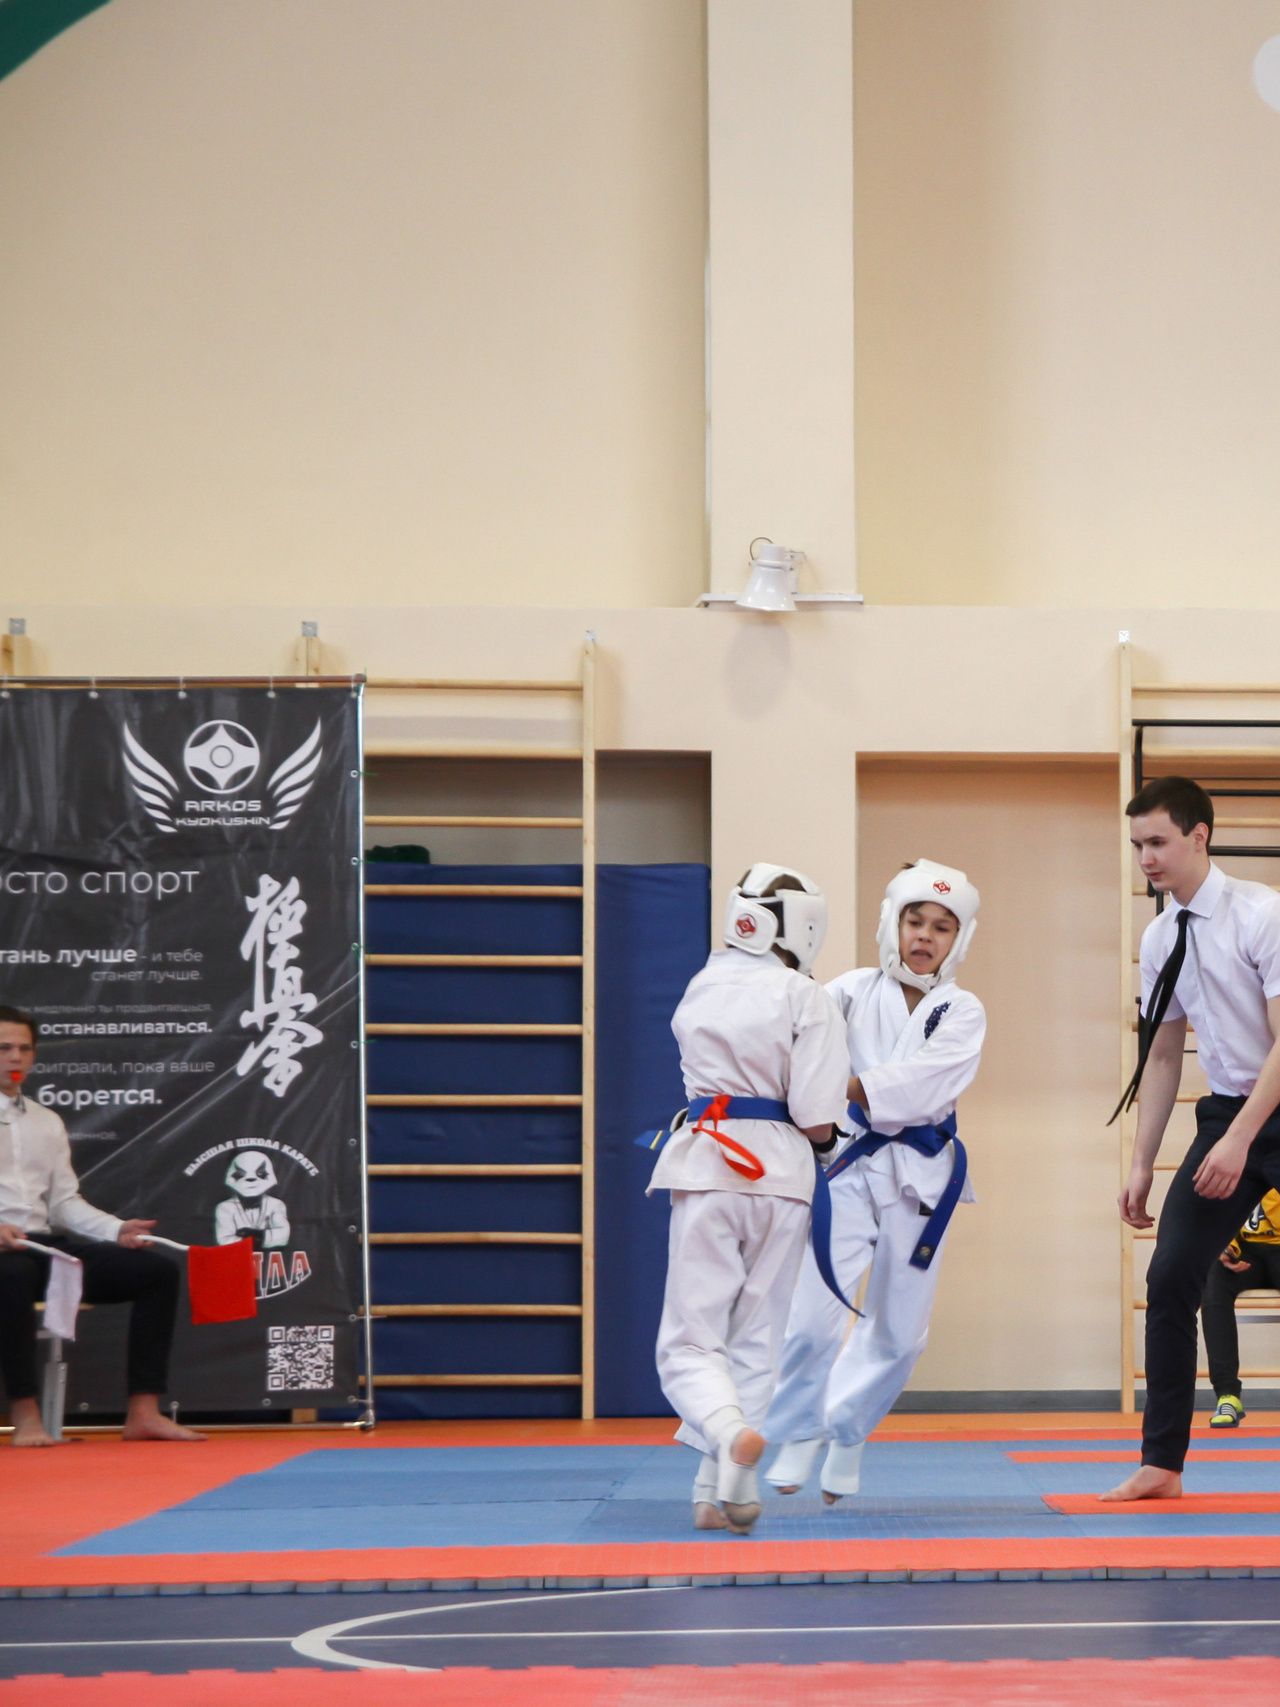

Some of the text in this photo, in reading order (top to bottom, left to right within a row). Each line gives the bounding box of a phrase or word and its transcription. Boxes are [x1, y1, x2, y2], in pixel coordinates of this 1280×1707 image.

[184, 800, 261, 811] ARKOS
[0, 871, 200, 900] сто спорт
[56, 949, 137, 967] лучше
[152, 952, 163, 962] и
[166, 948, 203, 962] тебе
[91, 970, 203, 983] станет лучше.
[39, 1022, 213, 1034] останавливаться.
[122, 1061, 165, 1073] пока
[170, 1060, 215, 1072] ваше
[38, 1084, 163, 1110] борется.
[183, 1137, 320, 1177] ВЫСШАЯ ШКОЛА КАРАТЕ
